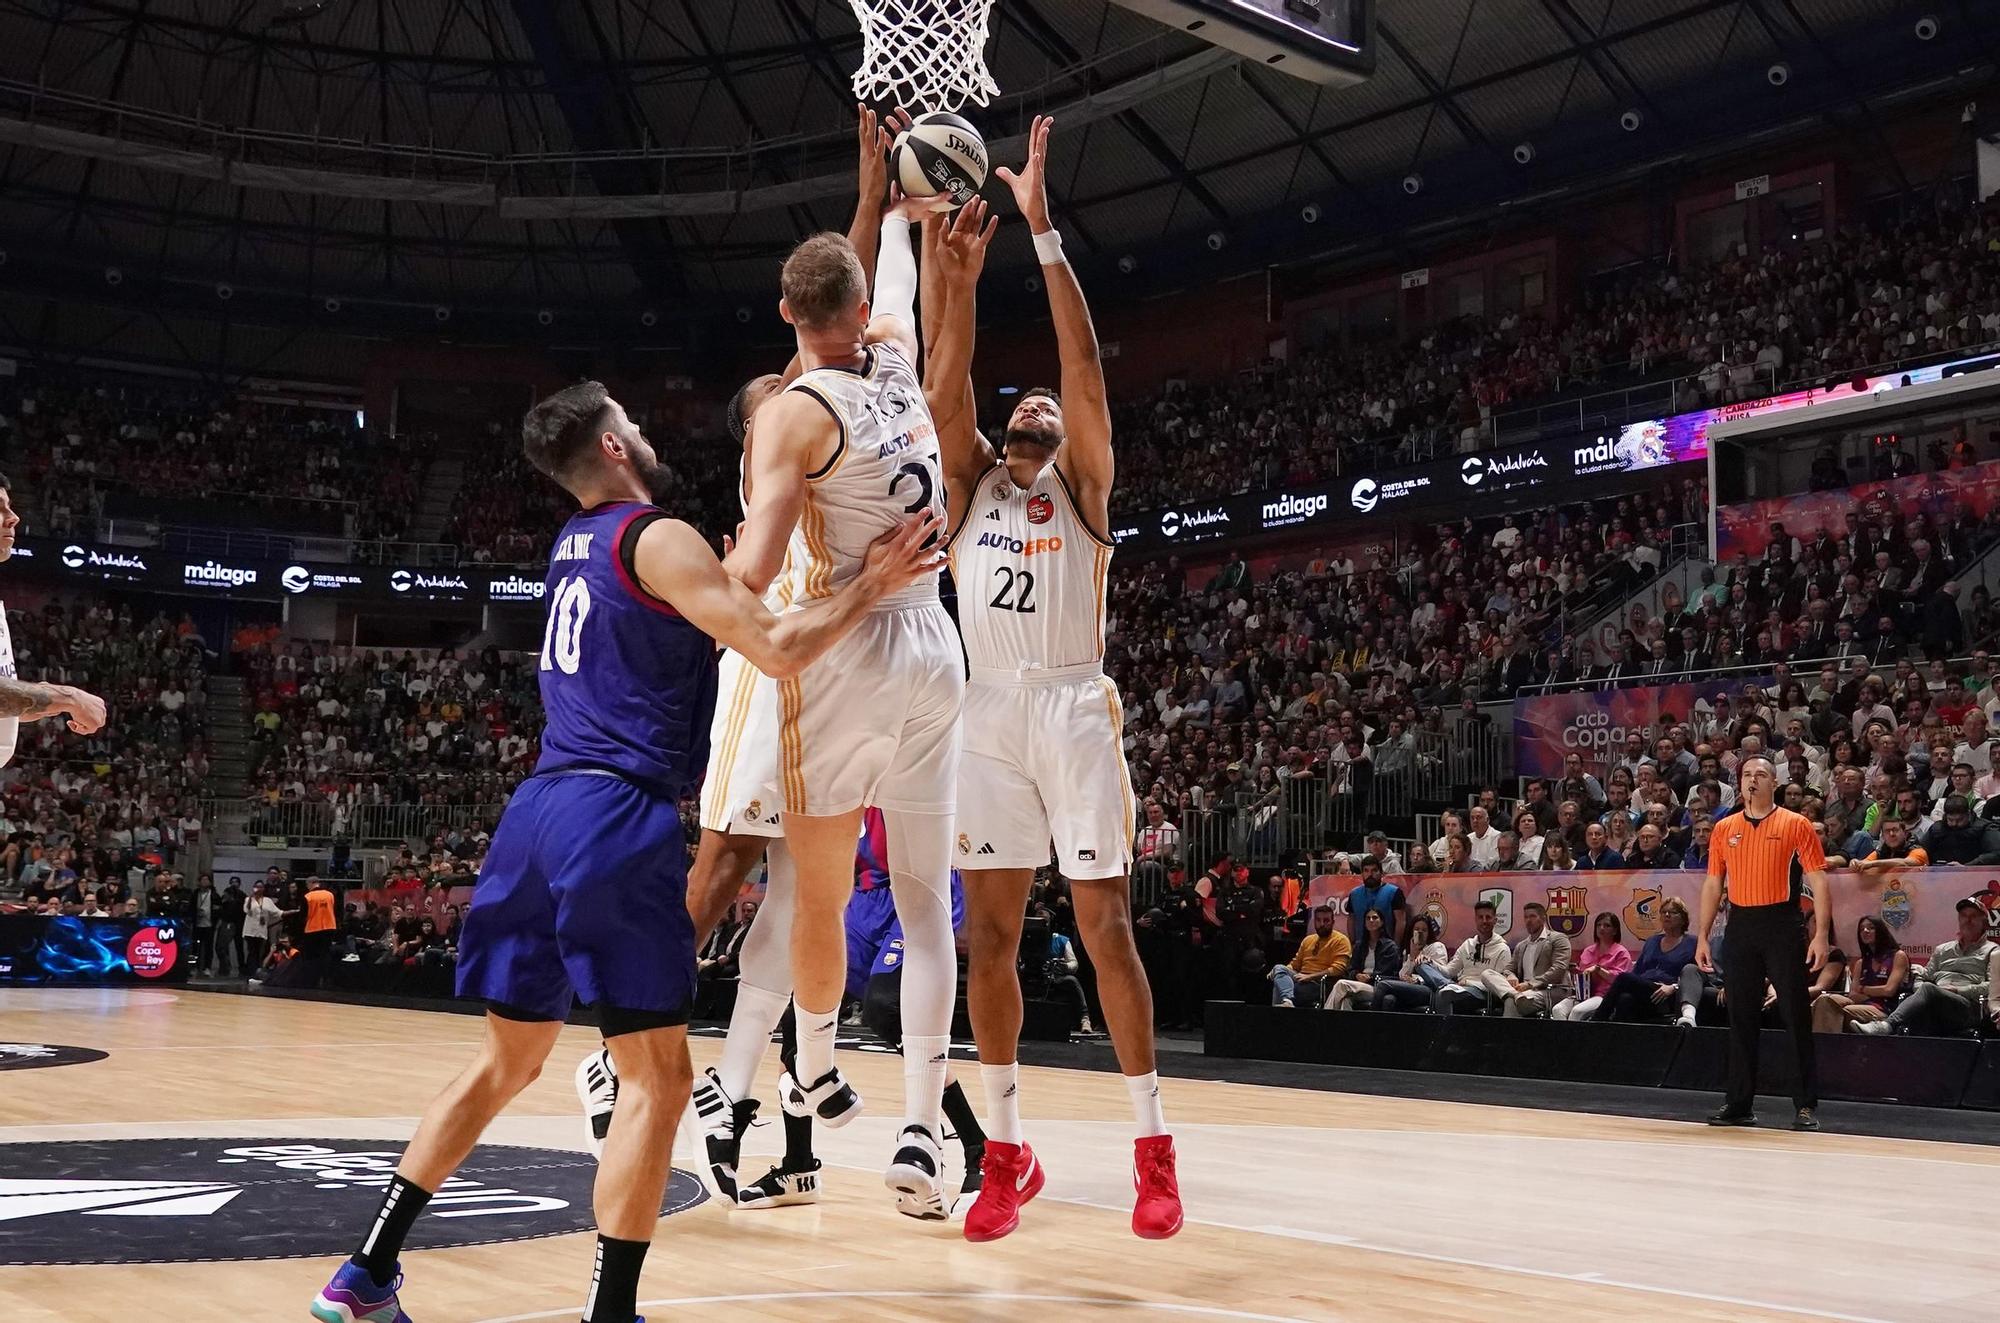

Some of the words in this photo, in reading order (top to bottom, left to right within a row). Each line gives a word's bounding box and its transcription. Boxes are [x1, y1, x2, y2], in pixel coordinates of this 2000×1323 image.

[1487, 449, 1548, 476] Andalucía
[1582, 465, 1602, 475] ciudad
[1381, 482, 1403, 492] COSTA
[1404, 480, 1417, 489] DEL
[1417, 477, 1430, 487] SOL
[1382, 488, 1410, 499] MÁLAGA
[1262, 494, 1327, 519] málaga
[1182, 507, 1230, 528] Andalucía
[1268, 518, 1285, 527] ciudad
[88, 550, 147, 570] Andalucía
[184, 561, 257, 586] málaga
[313, 574, 334, 583] COSTA
[348, 576, 362, 584] SOL
[415, 573, 468, 589] Andalucía
[490, 575, 547, 598] málag
[990, 566, 1036, 613] 22
[541, 576, 591, 675] 10
[1575, 709, 1609, 728] acb
[1563, 725, 1626, 750] Copa
[135, 946, 161, 956] Copa
[147, 955, 165, 966] Rey
